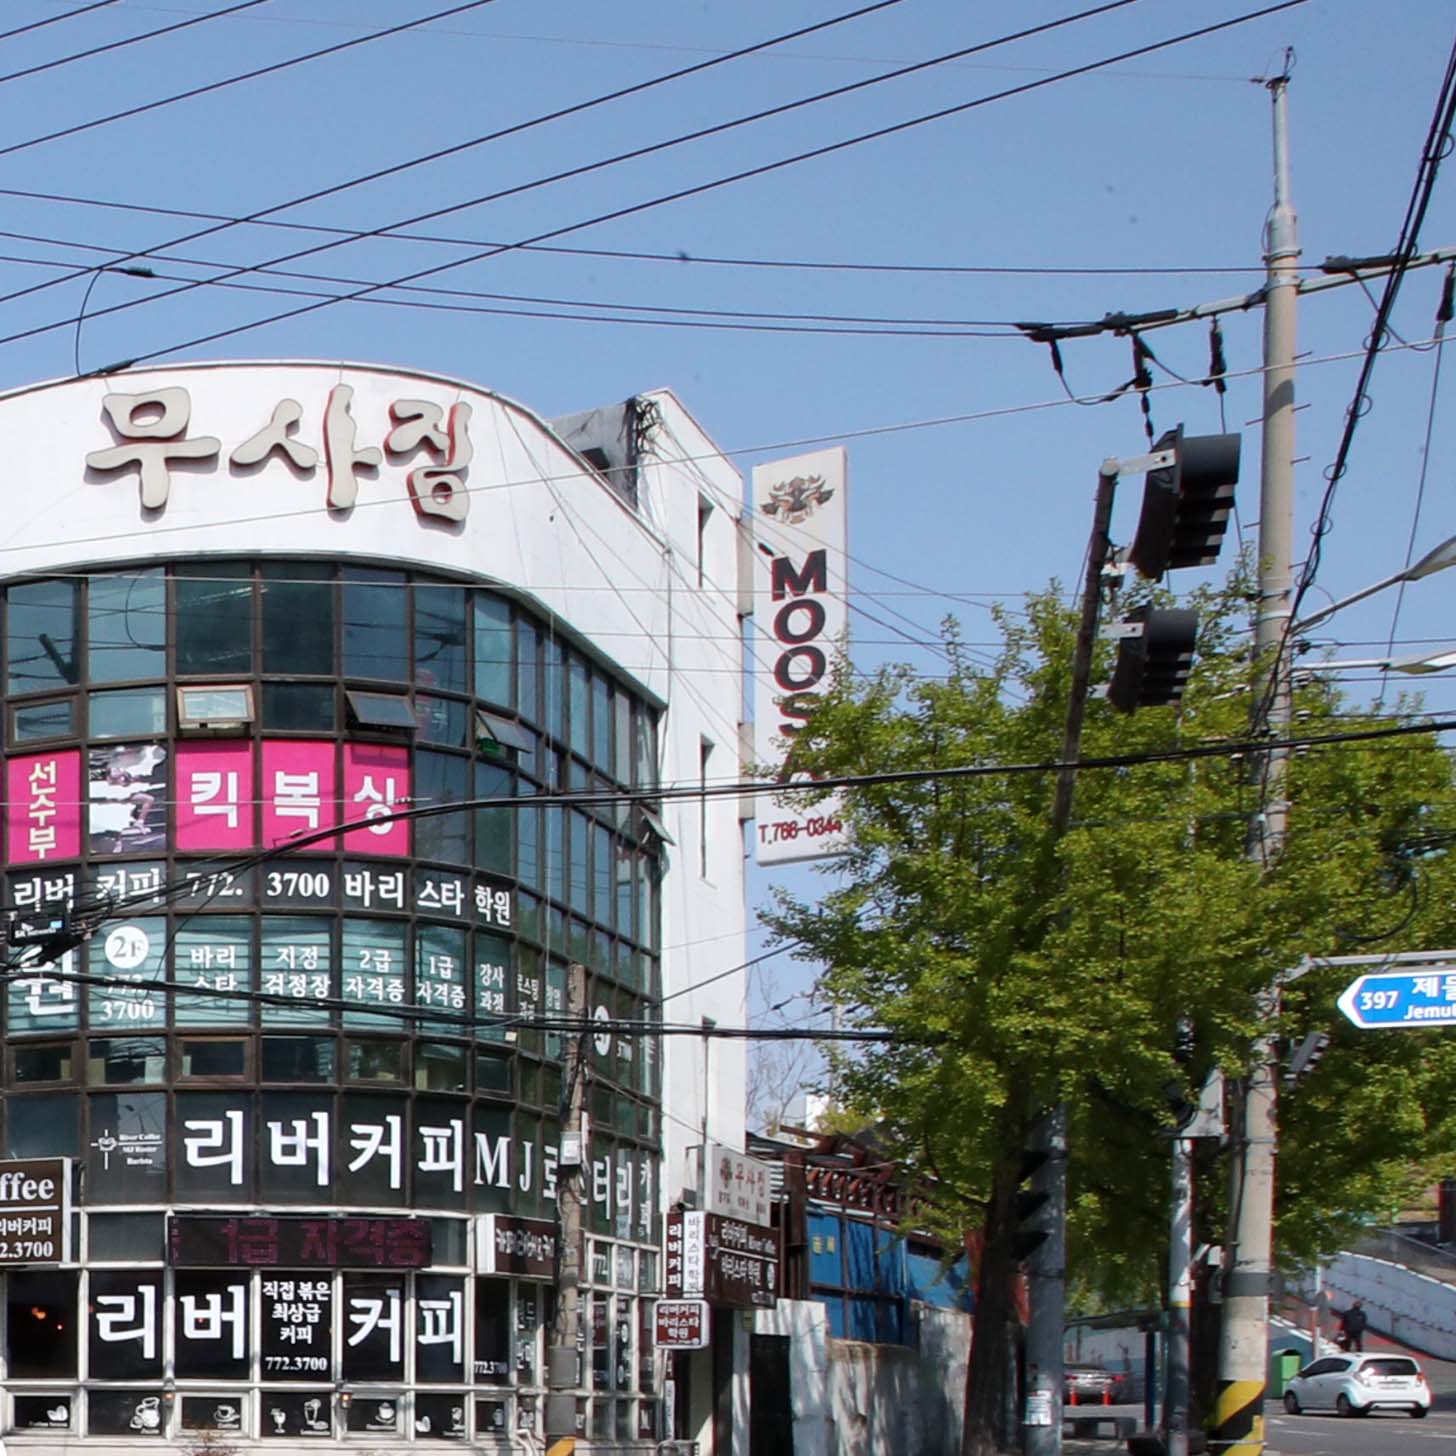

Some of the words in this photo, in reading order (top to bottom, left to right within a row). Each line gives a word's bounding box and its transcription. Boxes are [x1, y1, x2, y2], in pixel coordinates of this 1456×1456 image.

[28, 760, 57, 860] 선수부
[189, 770, 398, 837] 킥복싱
[275, 945, 319, 970] 지정
[358, 949, 393, 973] 2급
[429, 956, 455, 980] 1급
[265, 974, 331, 998] 검정장
[345, 976, 406, 1003] 자격증
[416, 981, 466, 1010] 자격증
[1359, 990, 1400, 1010] 397
[262, 1280, 294, 1301] 직접
[297, 1280, 332, 1300] 볶은
[271, 1302, 323, 1322] 최상급
[279, 1325, 313, 1345] 커피
[264, 1355, 328, 1372] 772.3700
